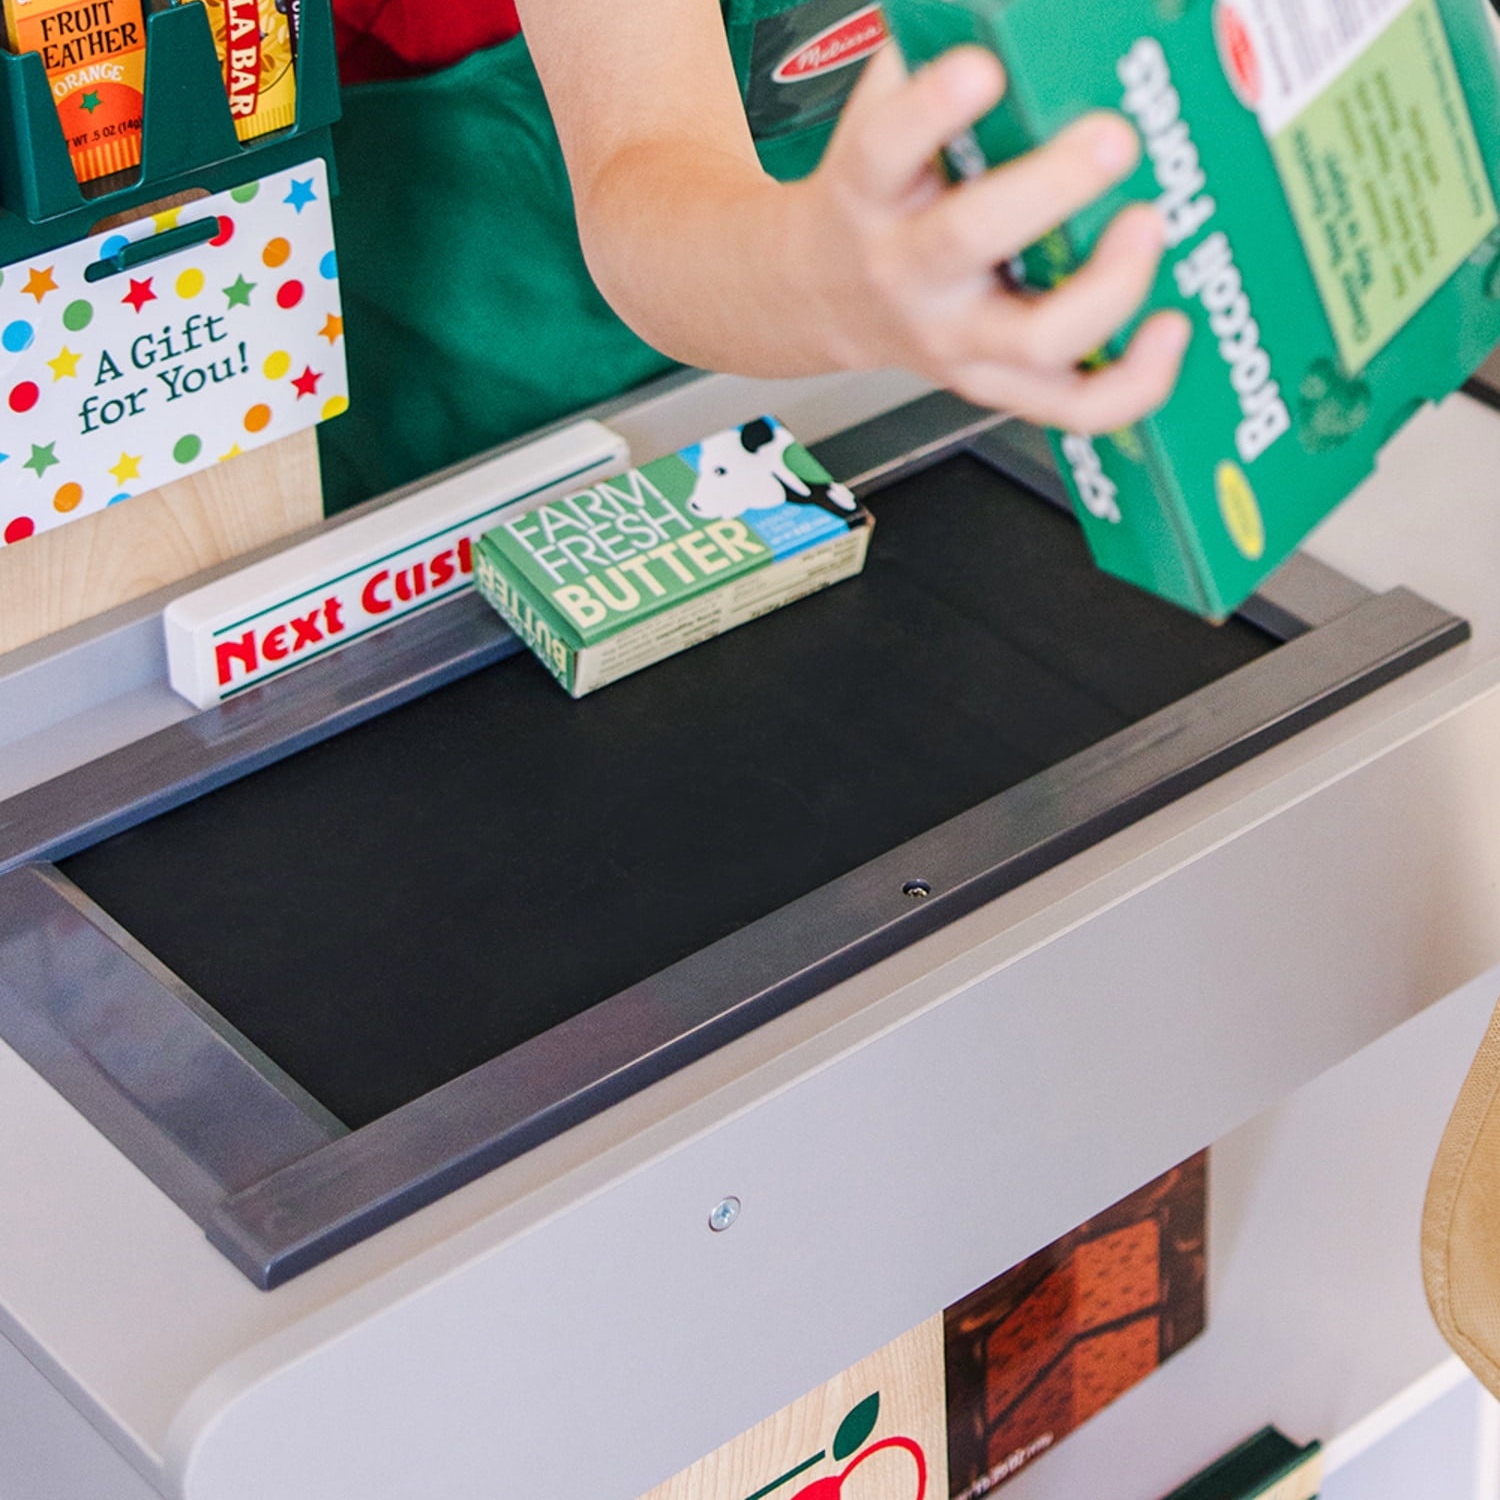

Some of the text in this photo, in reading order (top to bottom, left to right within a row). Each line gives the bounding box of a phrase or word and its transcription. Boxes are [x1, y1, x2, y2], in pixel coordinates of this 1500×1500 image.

[41, 0, 114, 41] FRUIT
[42, 22, 137, 70] EATHER
[54, 63, 125, 97] ORANGE
[229, 46, 257, 117] BAR
[72, 134, 88, 148] WT
[103, 125, 116, 137] OZ
[1116, 36, 1216, 248] Florets
[78, 341, 250, 435] for You!
[94, 314, 228, 386] A Gift
[1174, 231, 1291, 463] Broccoli
[504, 468, 665, 552] FARM
[534, 498, 694, 584] FRESH
[214, 536, 473, 686] Next Cust
[553, 519, 766, 628] BUTTER
